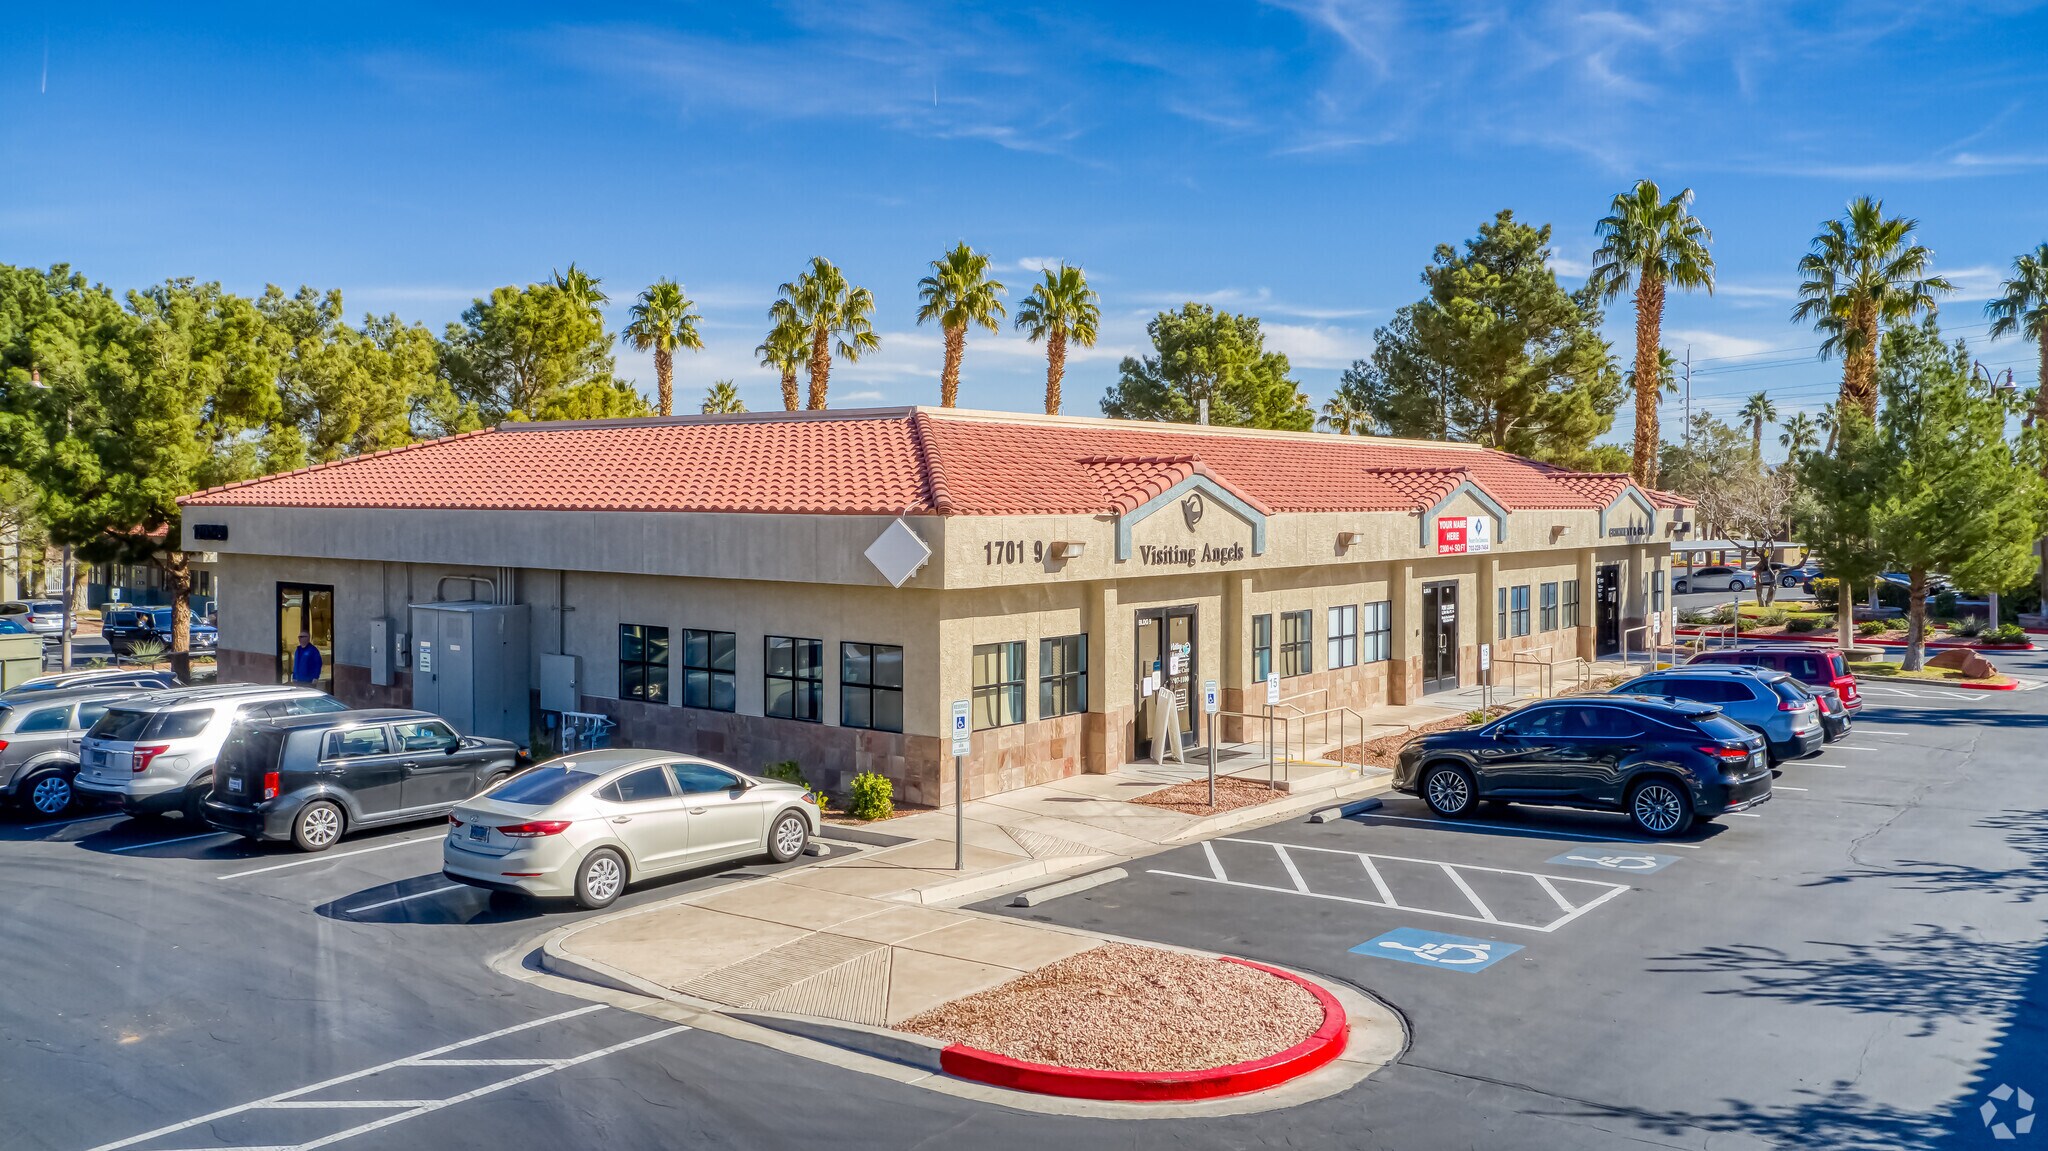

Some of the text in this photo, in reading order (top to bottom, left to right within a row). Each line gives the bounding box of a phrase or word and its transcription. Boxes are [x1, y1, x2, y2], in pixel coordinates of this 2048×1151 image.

[1439, 520, 1467, 529] YOUR NAME
[1446, 532, 1460, 541] HERE
[1139, 542, 1244, 568] Visiting Angels
[1138, 618, 1149, 626] BLDG
[1269, 678, 1278, 688] 15
